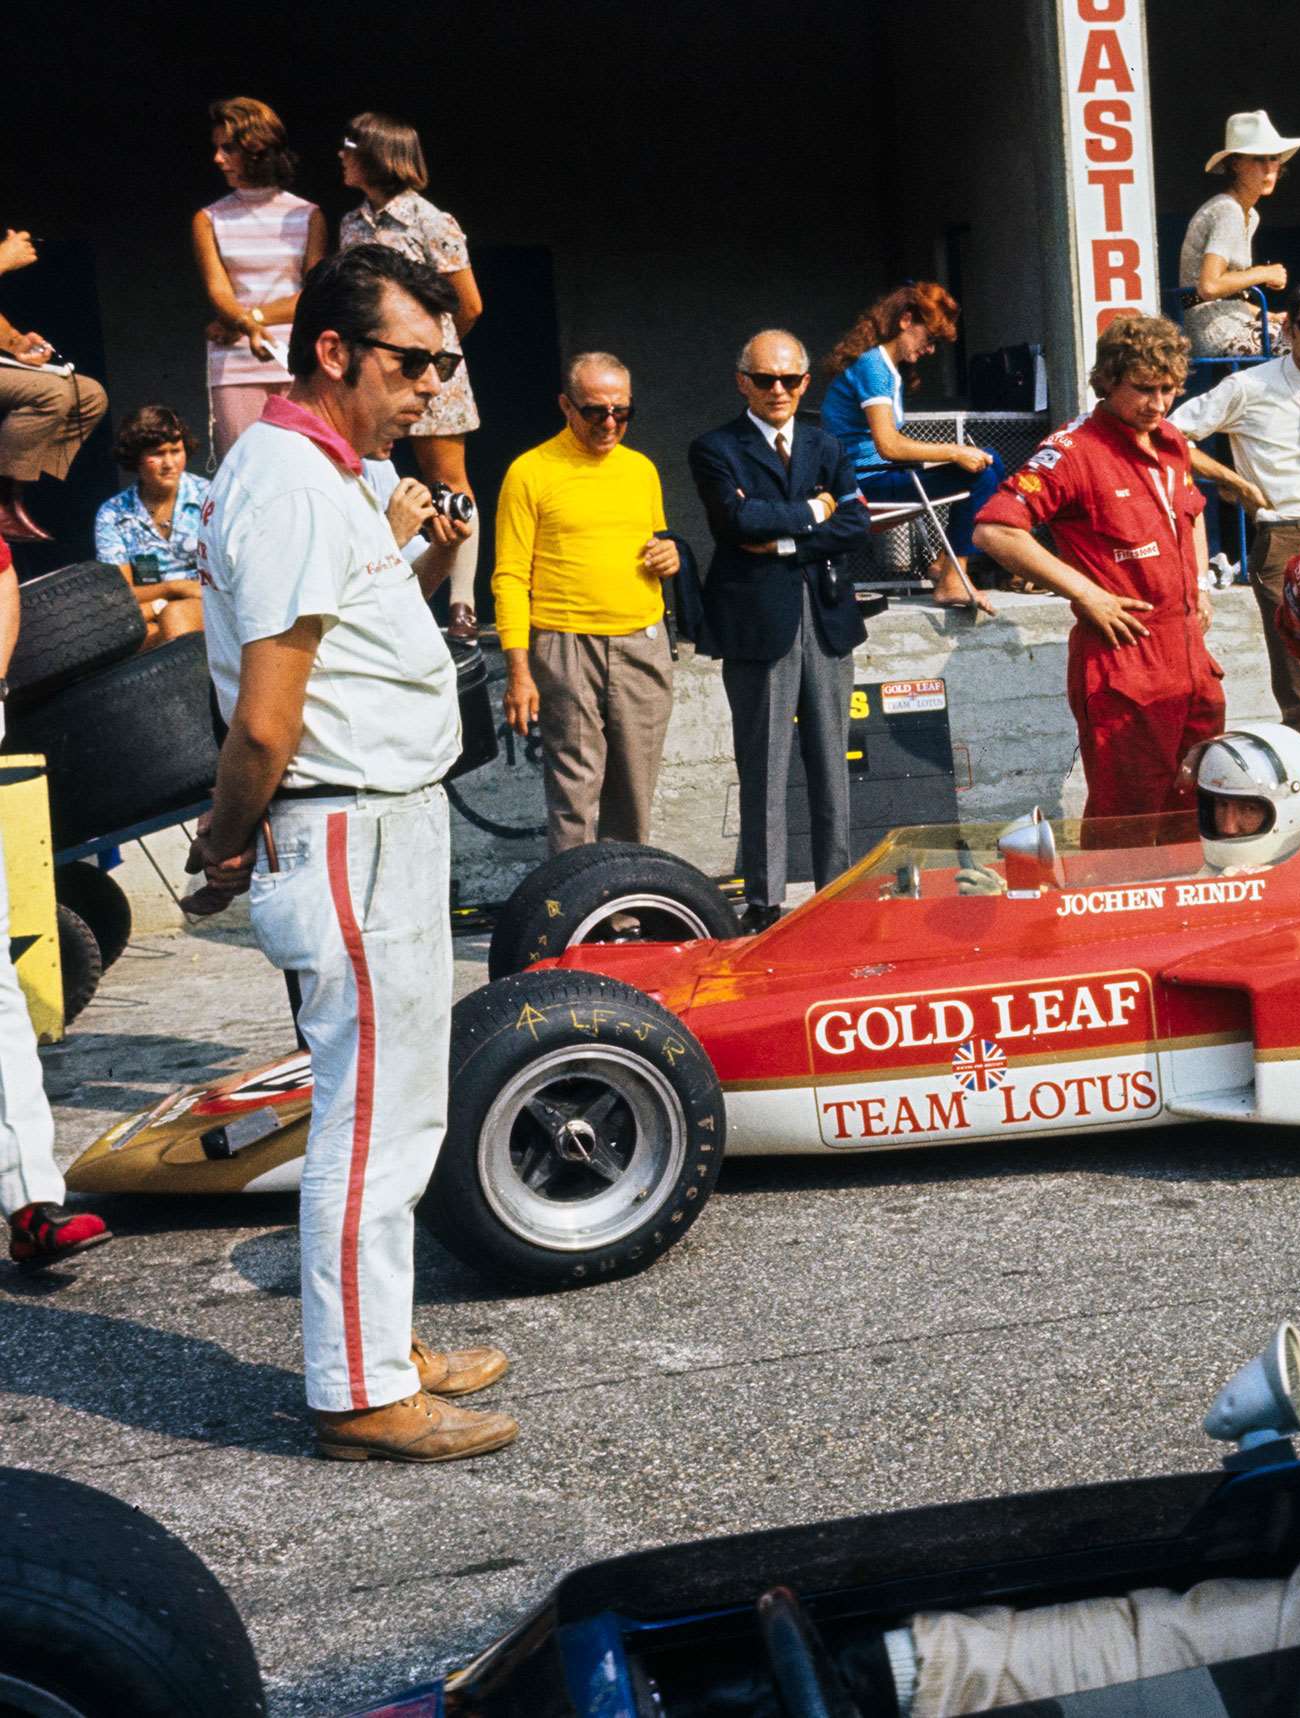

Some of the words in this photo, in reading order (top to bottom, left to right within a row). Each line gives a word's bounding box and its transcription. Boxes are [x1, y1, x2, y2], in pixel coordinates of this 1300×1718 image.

[1077, 0, 1144, 334] ASTR
[884, 684, 912, 695] GOLD
[1056, 887, 1166, 917] JOCHEN
[1175, 880, 1266, 907] RINDT
[814, 999, 976, 1056] GOLD
[991, 980, 1141, 1040] LEAF
[822, 1090, 972, 1140] TEAM
[1000, 1070, 1158, 1125] LOTUS
